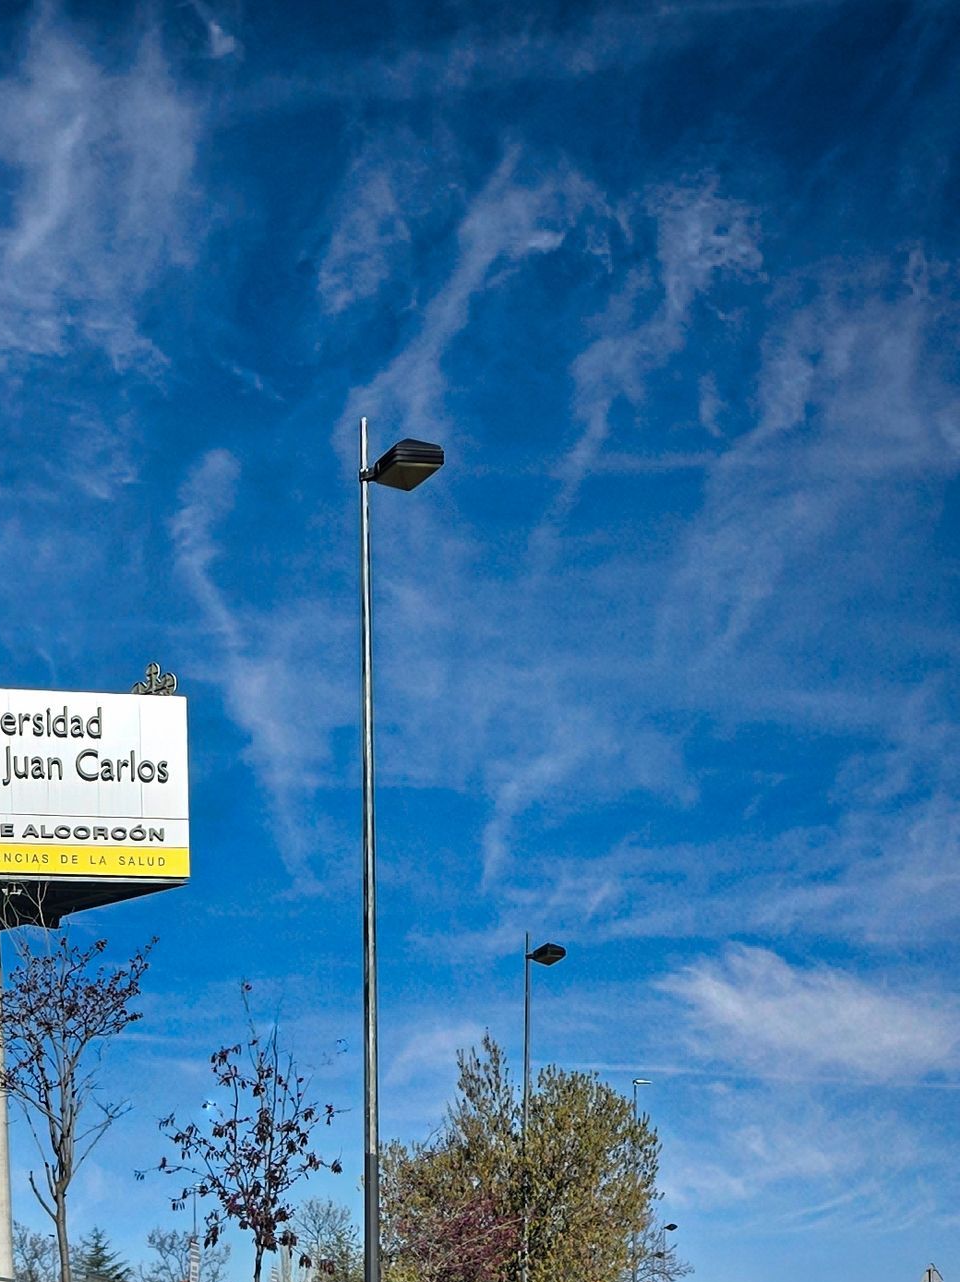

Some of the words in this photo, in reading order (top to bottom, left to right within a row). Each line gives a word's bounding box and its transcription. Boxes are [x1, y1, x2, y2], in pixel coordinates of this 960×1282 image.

[2, 745, 63, 786] Juan
[75, 748, 169, 784] Carlos
[22, 824, 165, 842] ALCORCÓN
[60, 854, 79, 865] DE
[90, 855, 107, 866] LA
[118, 856, 166, 867] SALUD
